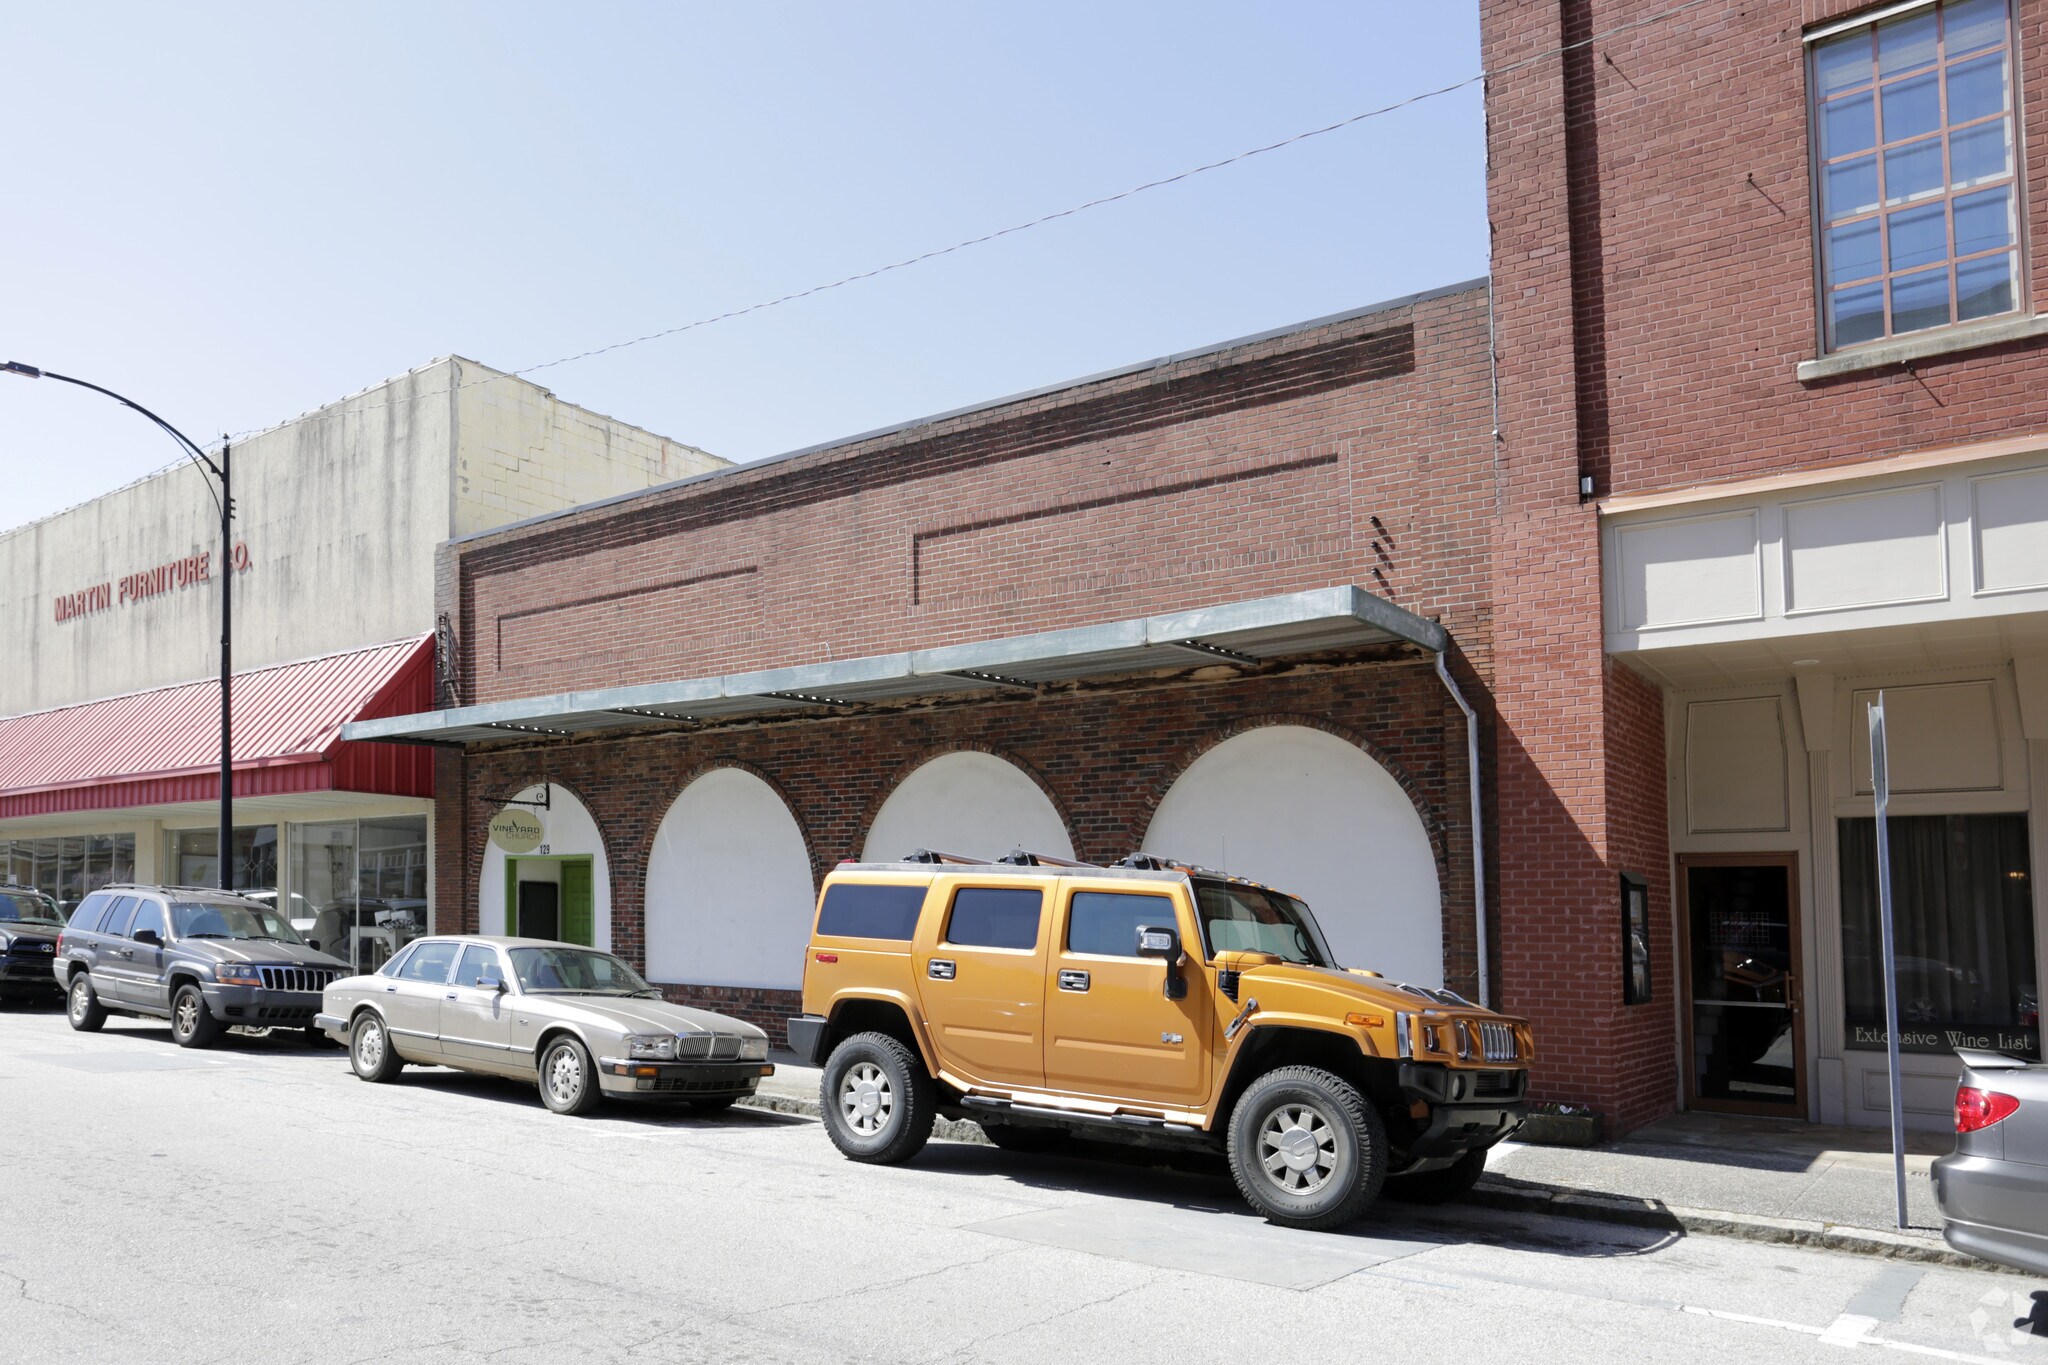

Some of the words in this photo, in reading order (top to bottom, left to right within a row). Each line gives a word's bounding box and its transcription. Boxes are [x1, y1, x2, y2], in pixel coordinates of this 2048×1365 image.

[54, 582, 111, 622] MARTIN
[117, 551, 210, 605] FURNITURE
[493, 820, 540, 834] VINEYARD
[505, 832, 540, 841] CHURCH
[1945, 1030, 1990, 1048] Wine
[1998, 1033, 2033, 1050] List
